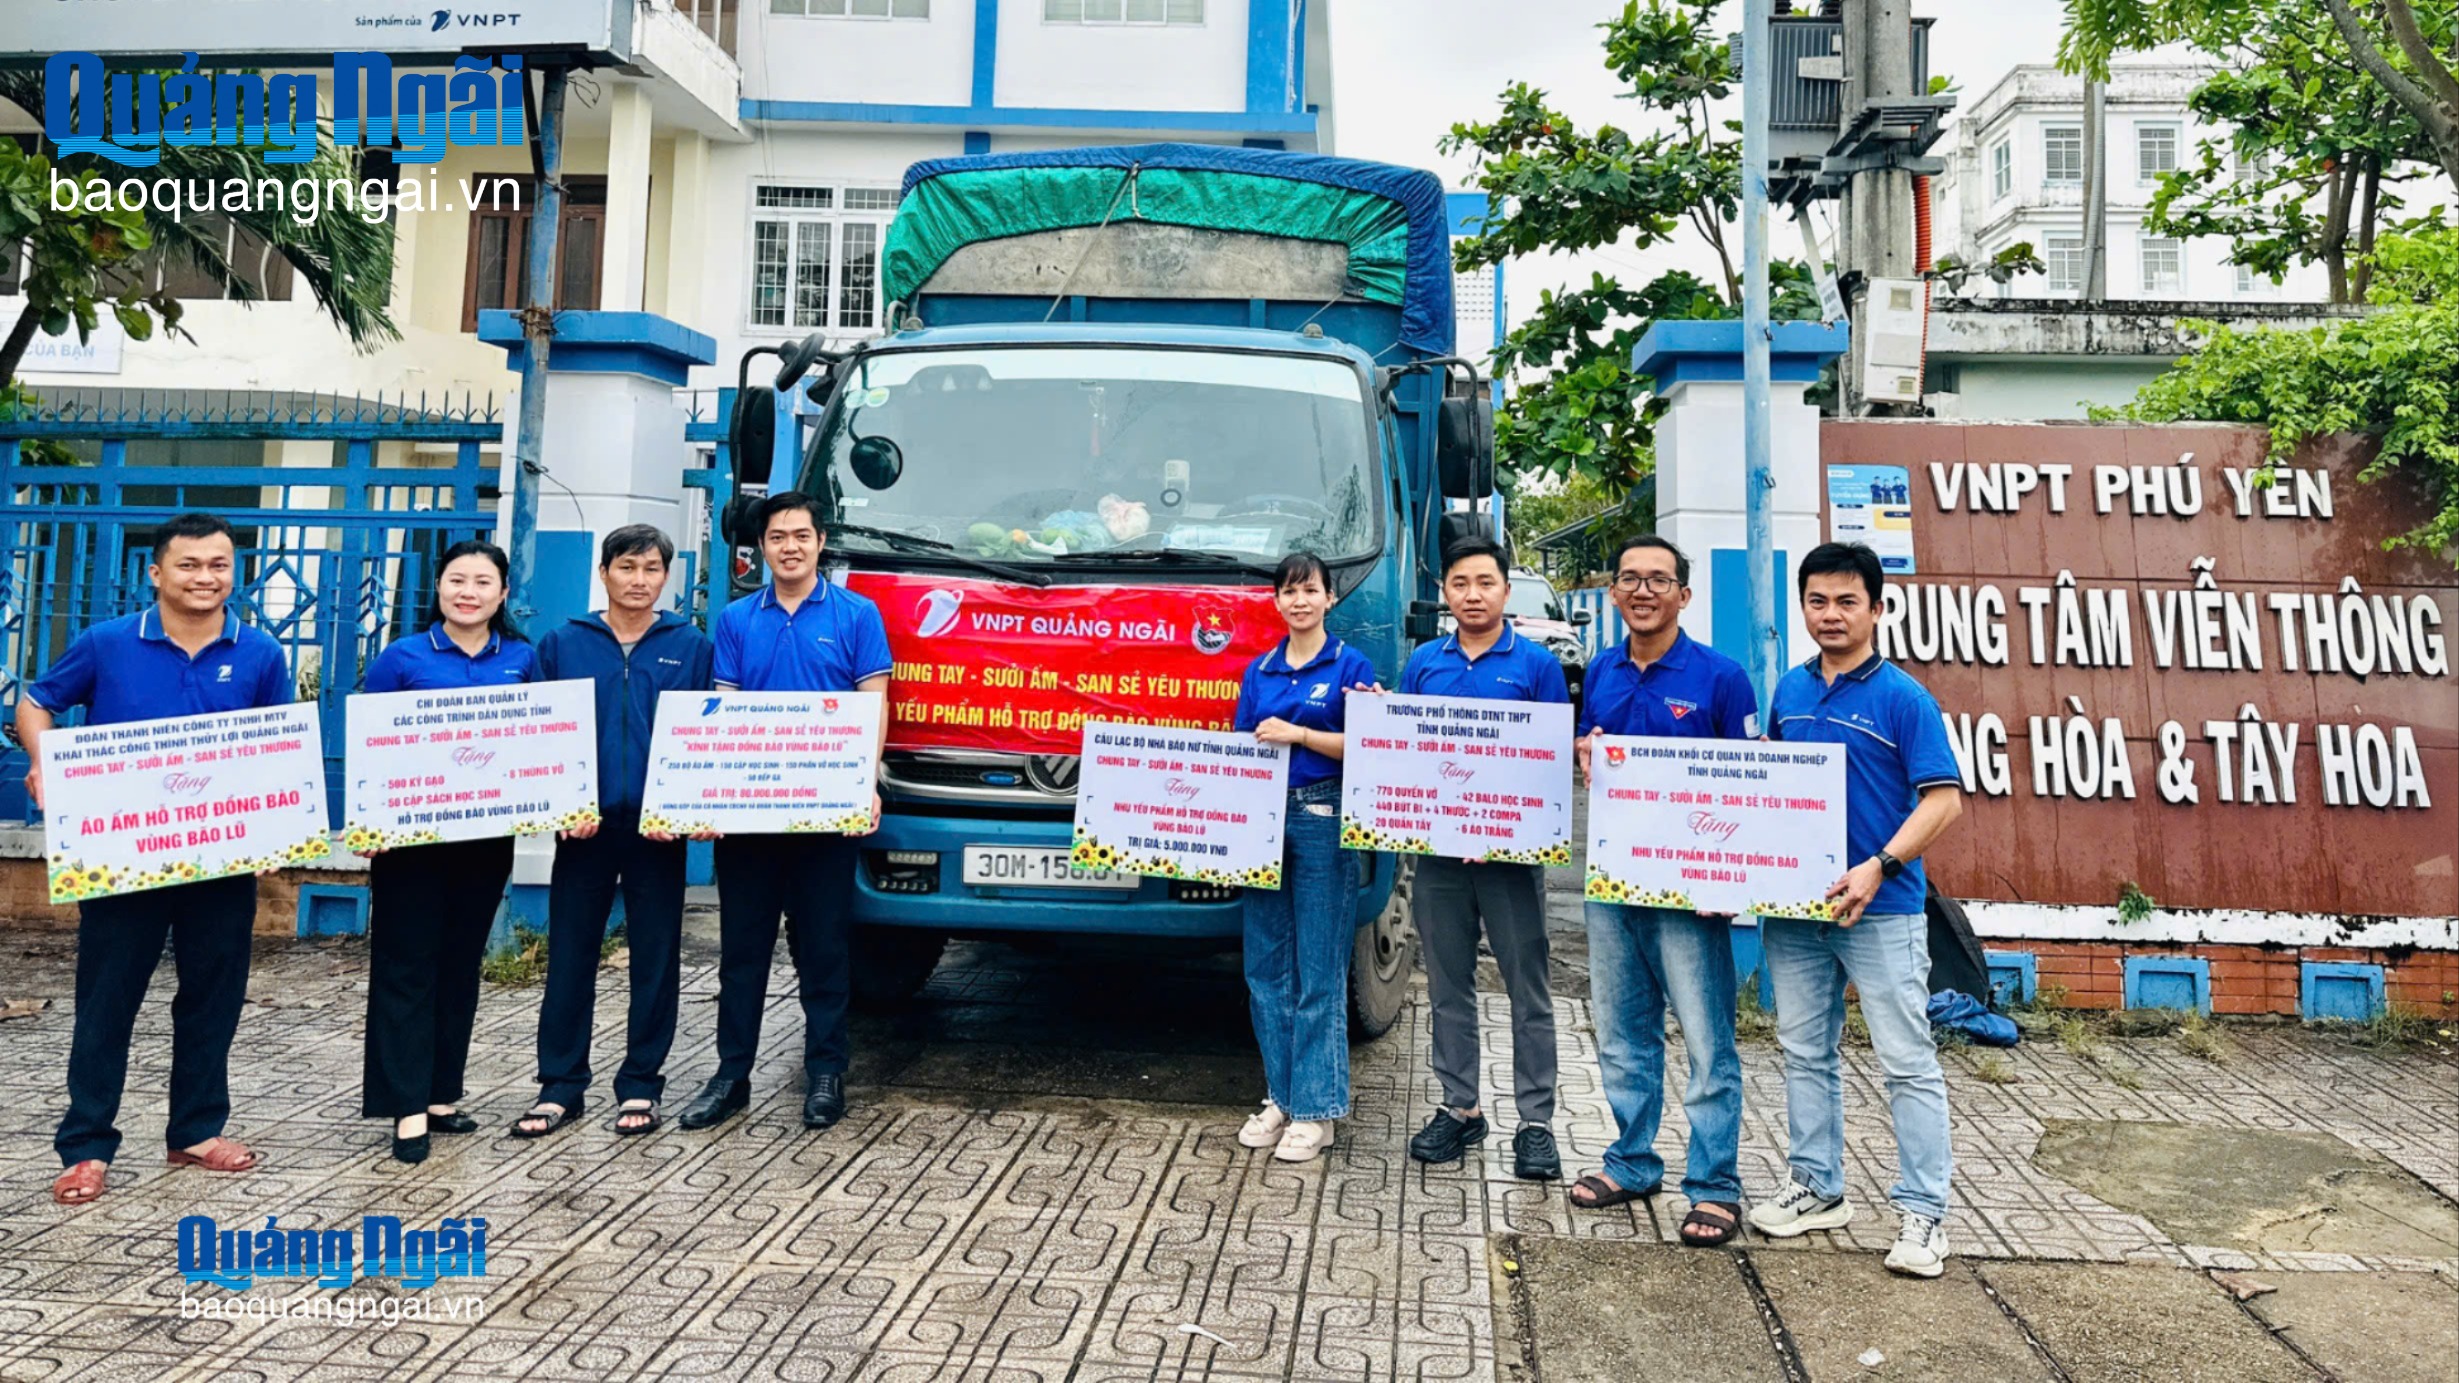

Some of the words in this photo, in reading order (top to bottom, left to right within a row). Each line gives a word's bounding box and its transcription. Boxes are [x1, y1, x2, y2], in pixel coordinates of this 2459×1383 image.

[355, 16, 373, 26] Sản
[458, 14, 521, 26] VNPT
[1928, 462, 2072, 513] VNPT
[2093, 451, 2203, 517] PHÚ
[2222, 456, 2334, 519] YÊN
[971, 613, 1025, 633] VNPT
[1031, 612, 1112, 639] QUẢNG
[1119, 619, 1176, 642] NGÃI
[1877, 583, 2010, 664] RUNG
[2018, 569, 2134, 667] TÂM
[2142, 555, 2263, 671] VIỄN
[2267, 575, 2450, 677] THÔNG
[891, 662, 932, 683] UNG
[937, 665, 965, 684] TAY
[982, 662, 1024, 688] SƯỞI
[1029, 664, 1058, 690] ẤM
[1076, 673, 1113, 694] SAN
[1118, 670, 1141, 695] SẺ
[1147, 674, 1180, 698] YÊU
[1186, 679, 1242, 701] THƯƠN
[895, 696, 927, 723] YẾU
[932, 699, 984, 727] PHẨM
[1018, 709, 1053, 734] TRỢ
[1941, 713, 2012, 796] NG
[2028, 695, 2137, 799] HÒA
[2157, 720, 2199, 805] &
[2203, 702, 2300, 804] TÂY
